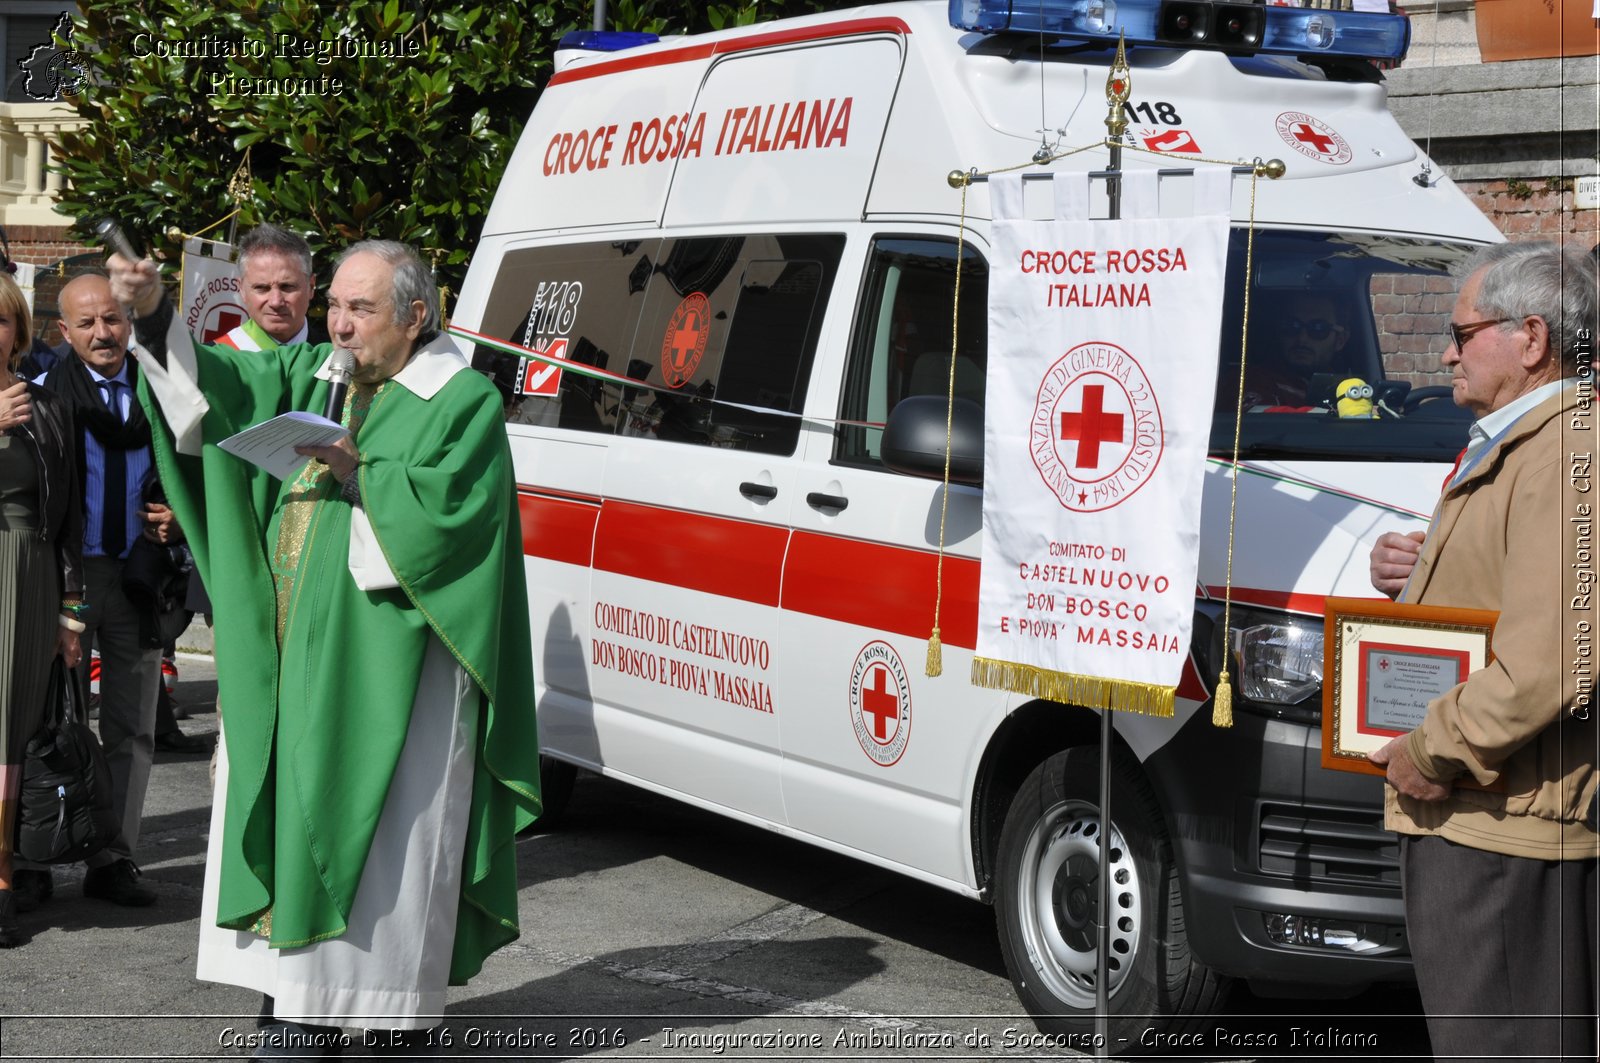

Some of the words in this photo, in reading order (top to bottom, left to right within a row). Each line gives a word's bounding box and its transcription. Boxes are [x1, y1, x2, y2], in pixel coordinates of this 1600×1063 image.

[1121, 101, 1182, 126] 118
[543, 124, 618, 177] CROCE
[621, 111, 707, 166] ROSSA
[715, 97, 853, 156] ITALIANA
[1021, 249, 1096, 275] CROCE
[1106, 247, 1188, 274] ROSSA
[207, 276, 241, 297] ROSS
[1047, 283, 1152, 308] ITALIANA
[537, 281, 583, 335] 118
[1052, 362, 1072, 387] DI
[1071, 348, 1133, 384] GINEVRA
[1129, 382, 1149, 406] 22
[1033, 382, 1075, 503] CONVENZIONE
[1123, 409, 1156, 482] AGOSTO
[1093, 474, 1126, 505] 1864
[1049, 541, 1105, 560] COMITATO
[1111, 547, 1126, 562] DI
[1019, 562, 1170, 594] CASTELNUOVO
[1027, 593, 1055, 612] DON
[1066, 597, 1147, 622] BOSCO
[595, 601, 655, 642] COMITATO
[657, 616, 671, 646] DI
[673, 620, 769, 671] CASTELNUOVO
[1001, 616, 1009, 633] E
[1077, 626, 1179, 654] MASSAIA
[592, 638, 616, 670] DON
[617, 645, 657, 682] BOSCO
[660, 656, 667, 685] E
[670, 659, 711, 696] PIOVA'
[713, 670, 774, 714] MASSAIA
[851, 657, 865, 706] CROCE
[863, 645, 889, 662] ROSSA
[890, 654, 909, 721] ITALIANA
